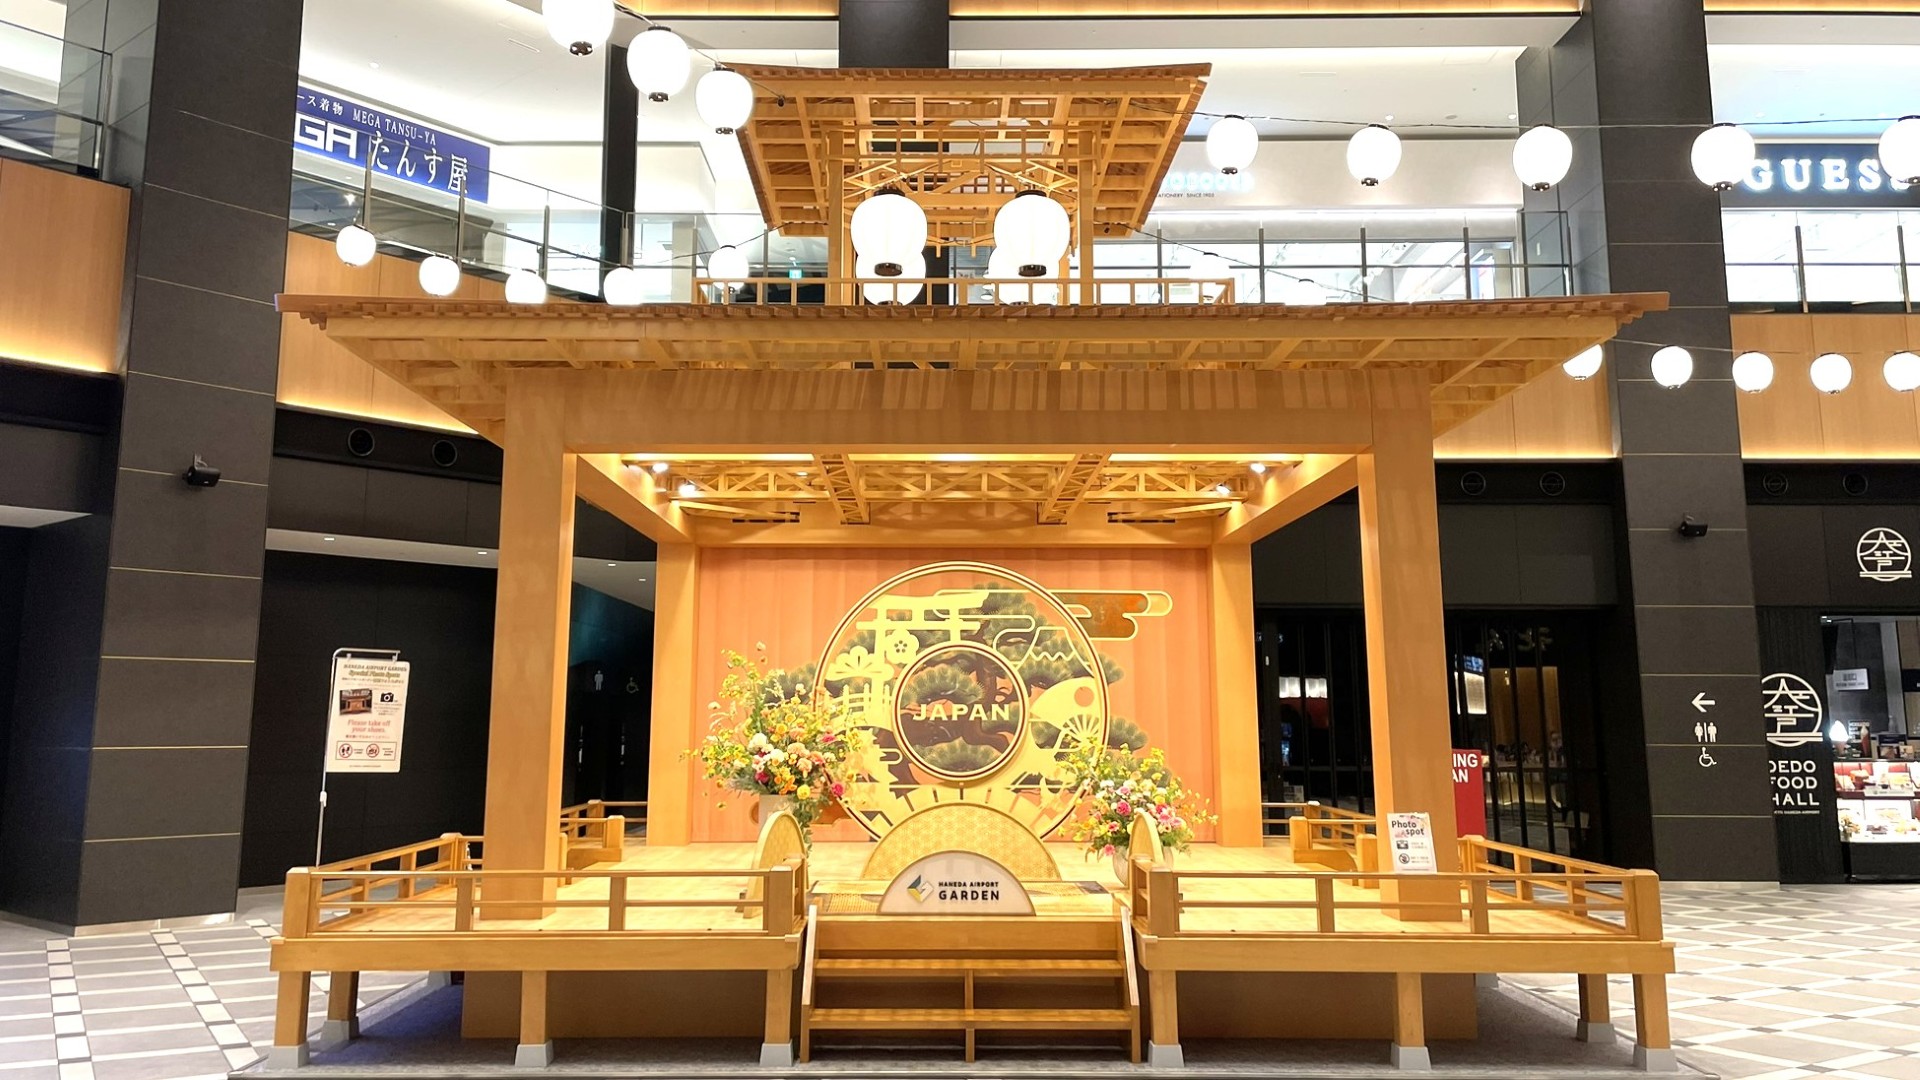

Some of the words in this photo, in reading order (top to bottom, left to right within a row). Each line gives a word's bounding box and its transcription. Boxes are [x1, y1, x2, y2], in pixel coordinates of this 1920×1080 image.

[353, 108, 381, 129] MEGA
[385, 118, 436, 146] TANSU-YA
[295, 112, 357, 159] GA
[371, 130, 468, 195] たんす屋
[912, 704, 1010, 721] JAPAN
[1453, 753, 1478, 768] ING
[1391, 820, 1417, 828] Photo
[1406, 828, 1424, 836] spot
[938, 890, 999, 901] GARDEN
